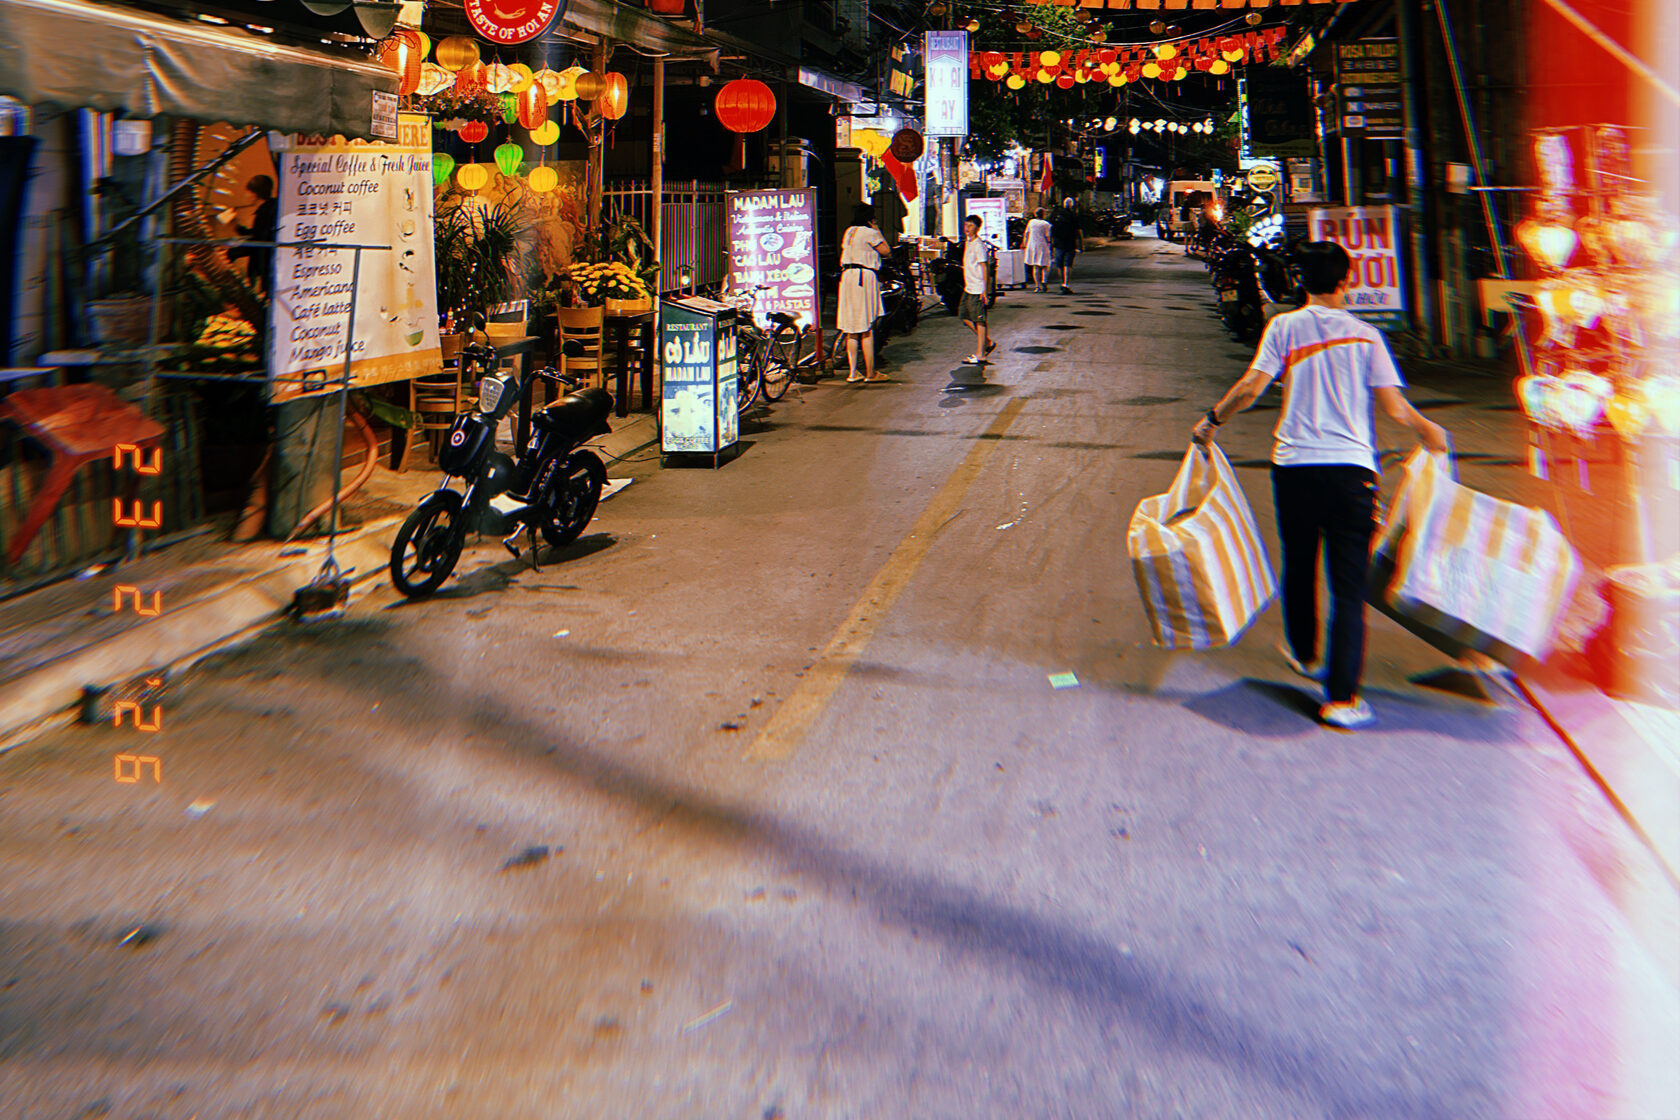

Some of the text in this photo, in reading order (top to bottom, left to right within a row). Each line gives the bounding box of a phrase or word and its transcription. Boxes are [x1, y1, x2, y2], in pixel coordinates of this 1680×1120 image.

[498, 27, 516, 40] OF
[517, 18, 541, 38] HOI
[537, 1, 554, 23] AN
[291, 154, 333, 177] Special
[335, 154, 367, 177] Coffee
[380, 154, 404, 176] Fresh
[407, 154, 430, 175] Juice
[297, 179, 379, 196] Coconut coffee
[332, 200, 352, 216] 커피
[734, 193, 806, 211] MADAM LAU
[294, 220, 356, 241] Egg coffee
[291, 263, 343, 281] Espresso
[291, 300, 353, 322] Café latte
[774, 299, 811, 310] PASTAS
[289, 322, 342, 344] Coconut
[666, 323, 709, 331] RESTAURANT
[287, 339, 366, 364] Mango juce
[664, 366, 695, 382] MADAM
[695, 366, 711, 382] LAU
